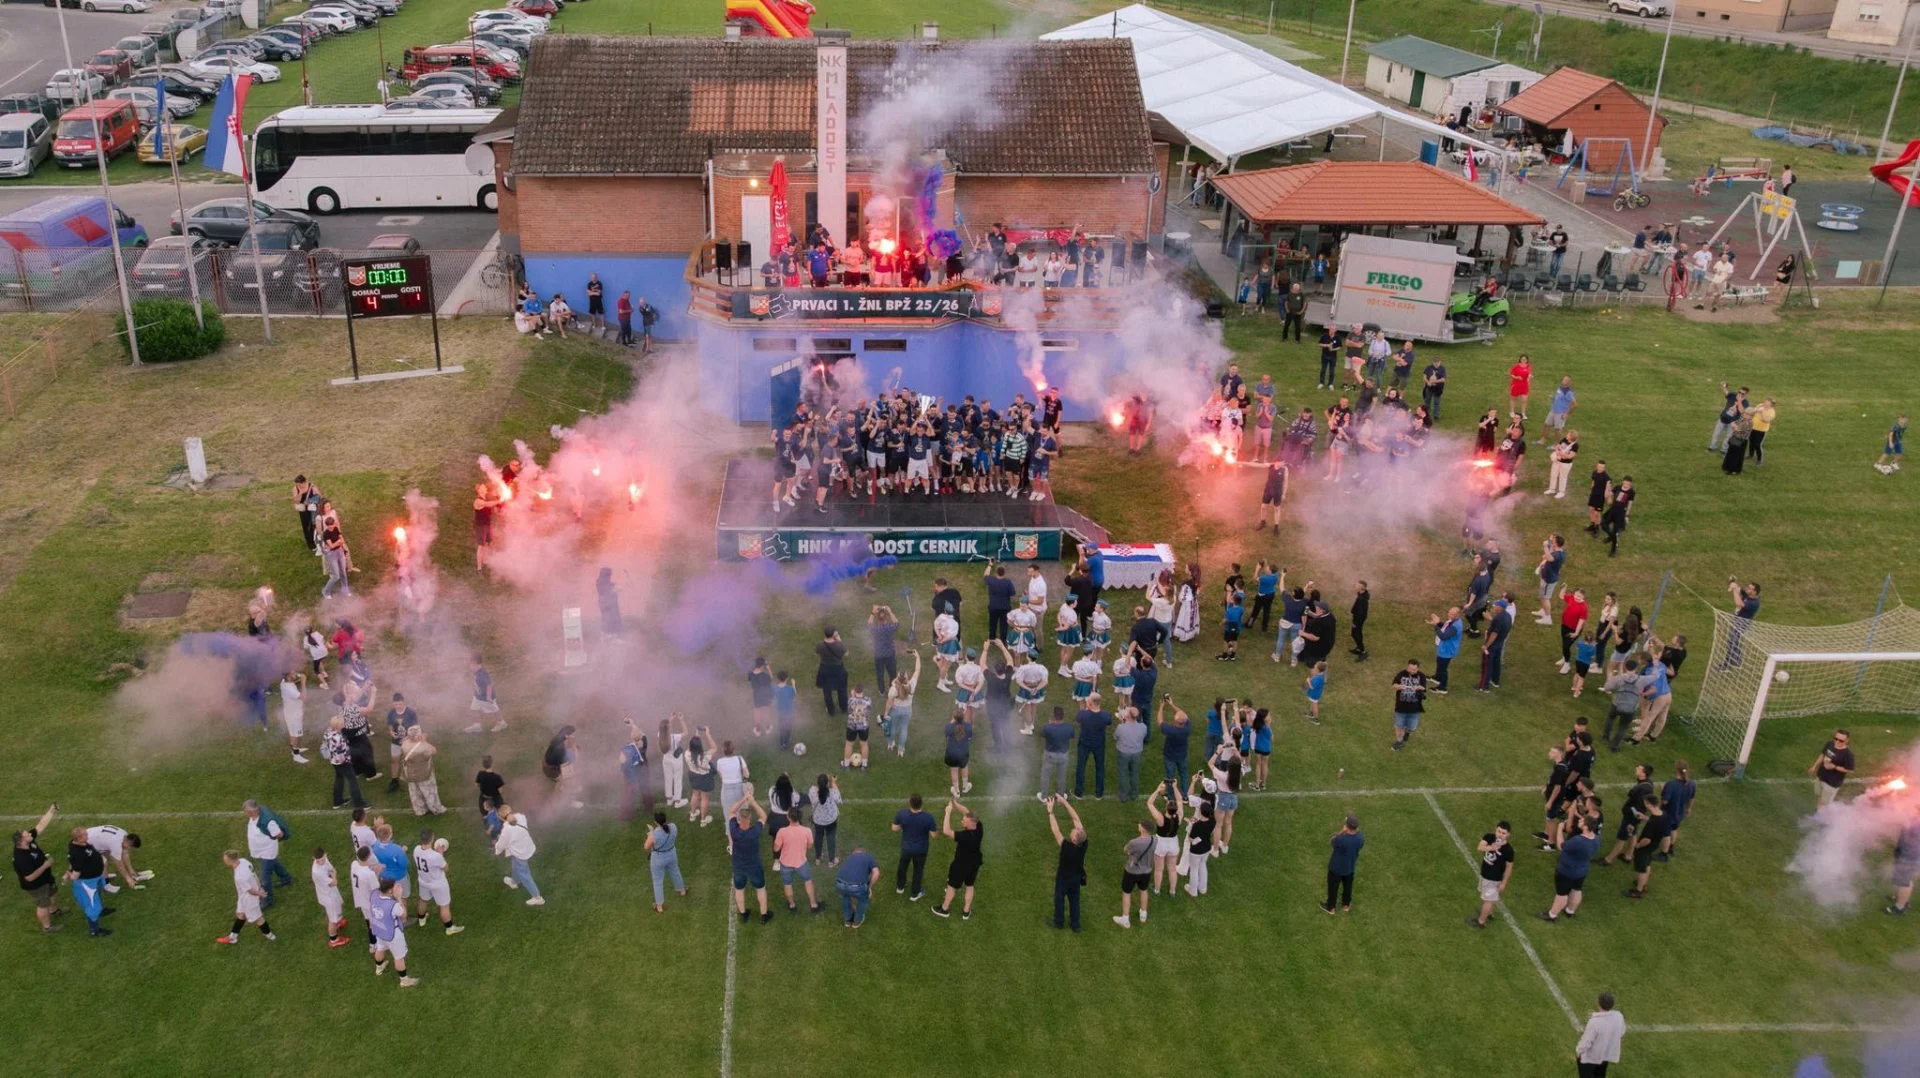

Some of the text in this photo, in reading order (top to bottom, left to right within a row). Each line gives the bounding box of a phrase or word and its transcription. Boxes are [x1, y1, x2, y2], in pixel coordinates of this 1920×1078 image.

[825, 71, 838, 173] MLADOST
[371, 261, 401, 270] VRIJEME
[368, 269, 406, 285] 00:00
[1365, 271, 1423, 290] FRIGO
[352, 285, 422, 297] DOMAĆI GOSTI
[1381, 283, 1406, 291] SERVIS
[366, 296, 377, 309] 4
[792, 297, 959, 313] PRVACI 1. ŽNL BPŽ 25/26
[798, 539, 832, 554] HNK
[919, 539, 978, 554] CERNIK
[416, 857, 429, 873] 13
[353, 874, 360, 888] 7
